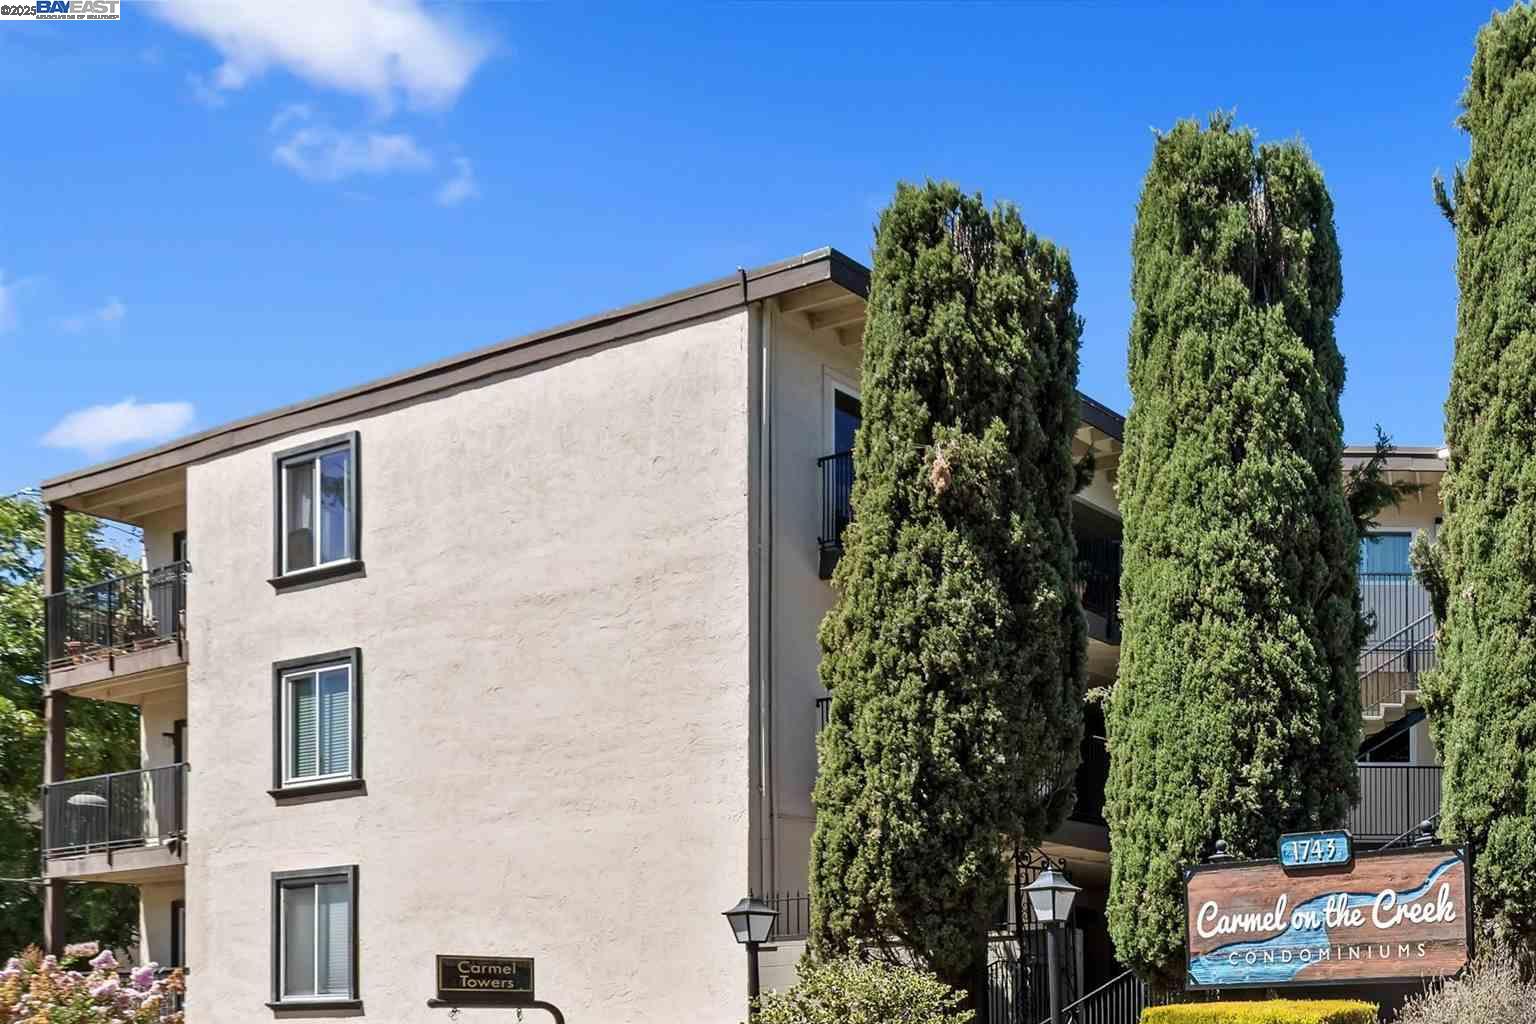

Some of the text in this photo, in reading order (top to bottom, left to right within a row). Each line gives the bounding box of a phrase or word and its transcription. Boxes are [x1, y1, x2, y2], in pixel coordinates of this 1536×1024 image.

[1291, 838, 1336, 863] 1743
[1196, 882, 1456, 939] Carmel on the Creek
[1228, 943, 1427, 966] CONDOMINIUMS
[457, 961, 516, 975] Carmel
[460, 975, 514, 988] Towers
